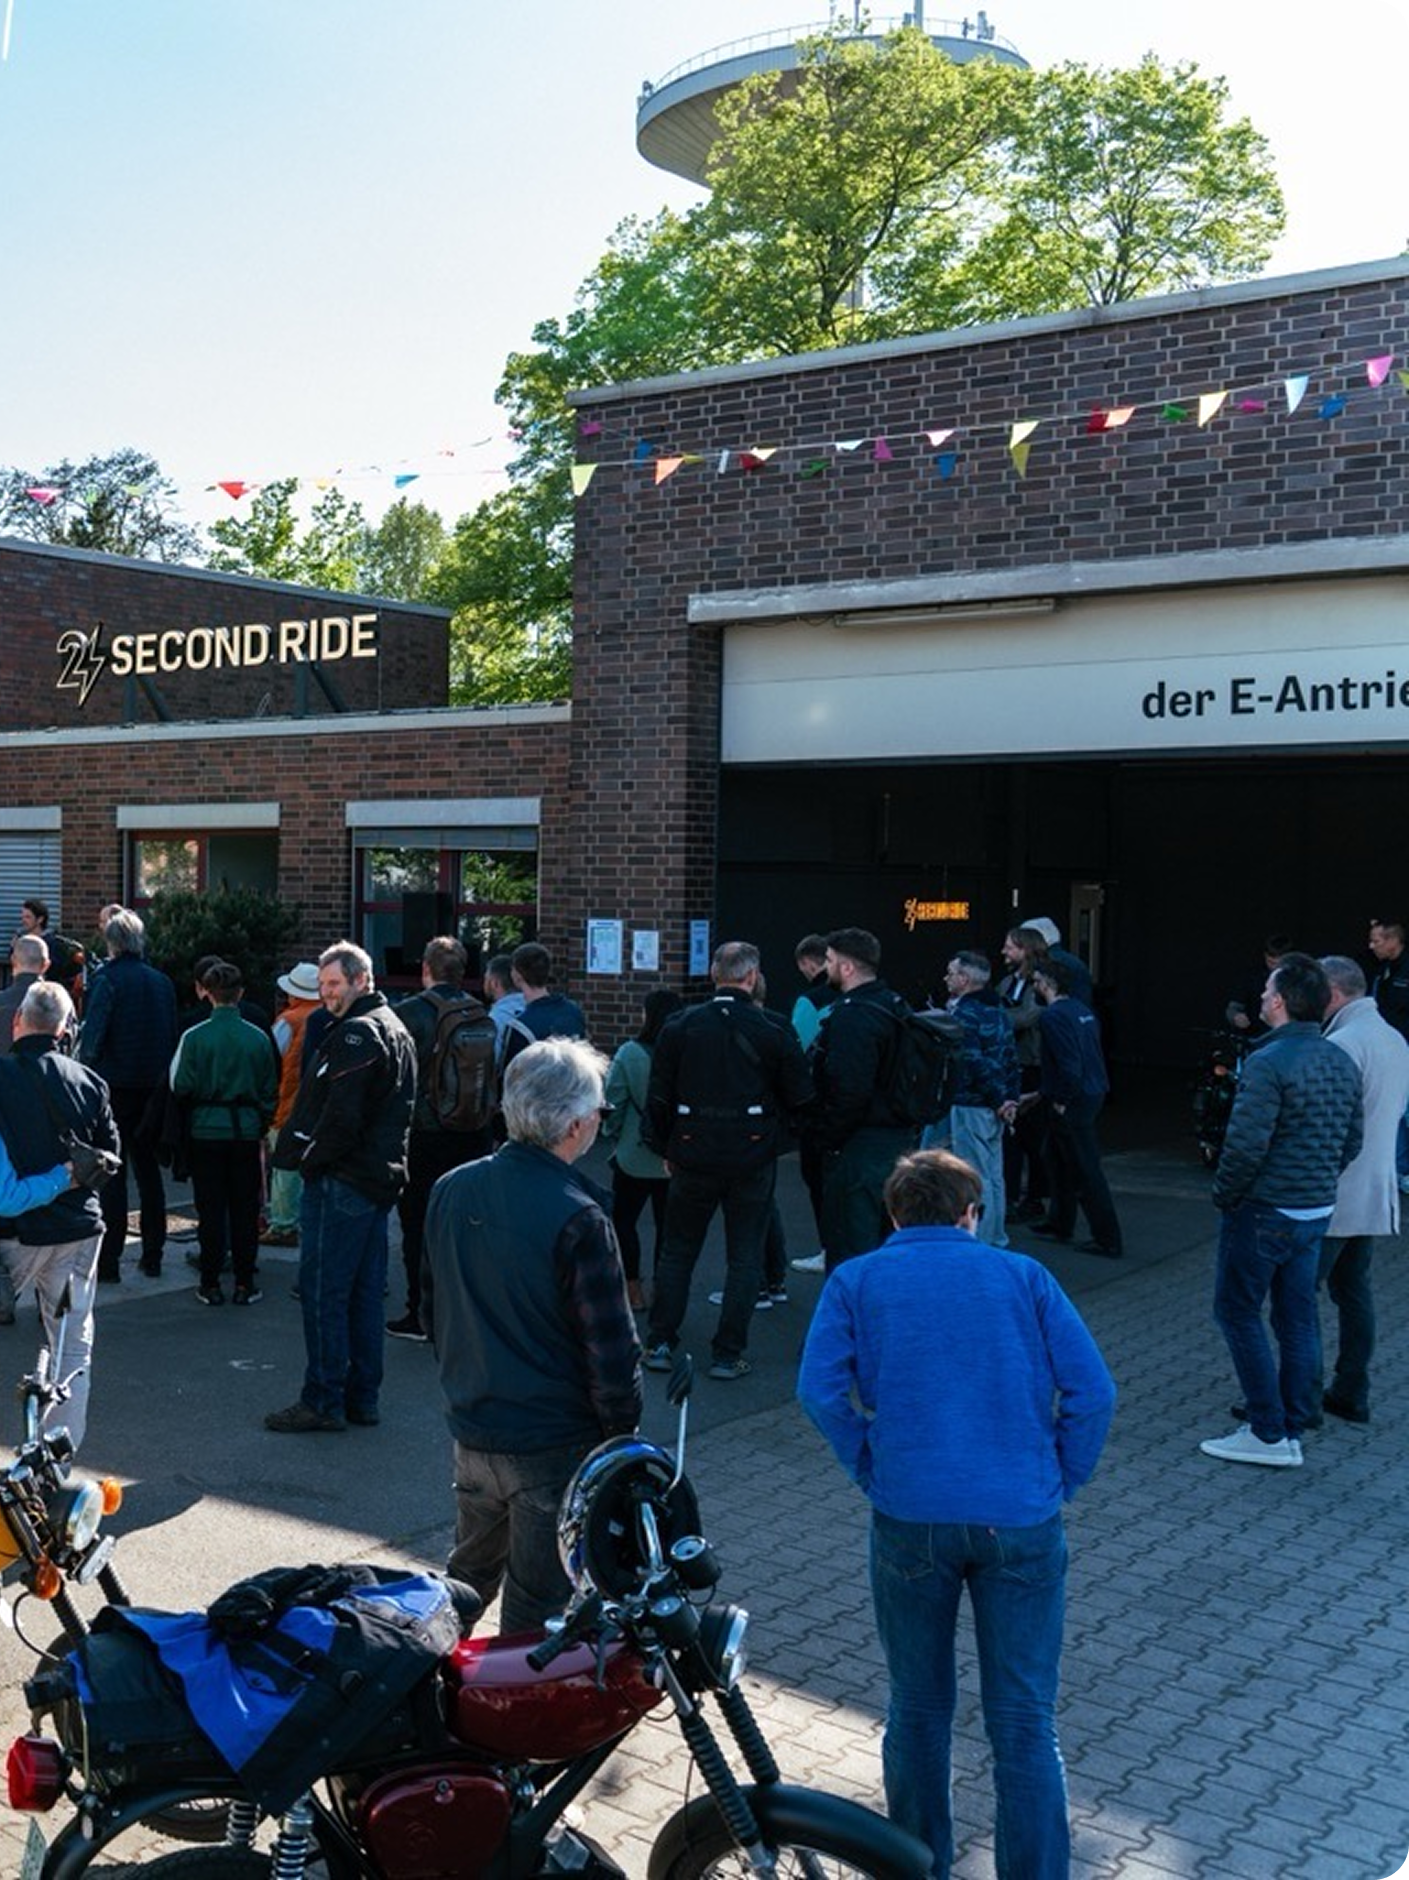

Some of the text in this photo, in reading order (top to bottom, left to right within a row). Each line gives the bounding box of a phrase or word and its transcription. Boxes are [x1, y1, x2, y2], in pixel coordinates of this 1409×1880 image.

[110, 624, 272, 676] SECOND
[279, 613, 379, 664] RIDE
[1142, 681, 1216, 719] der
